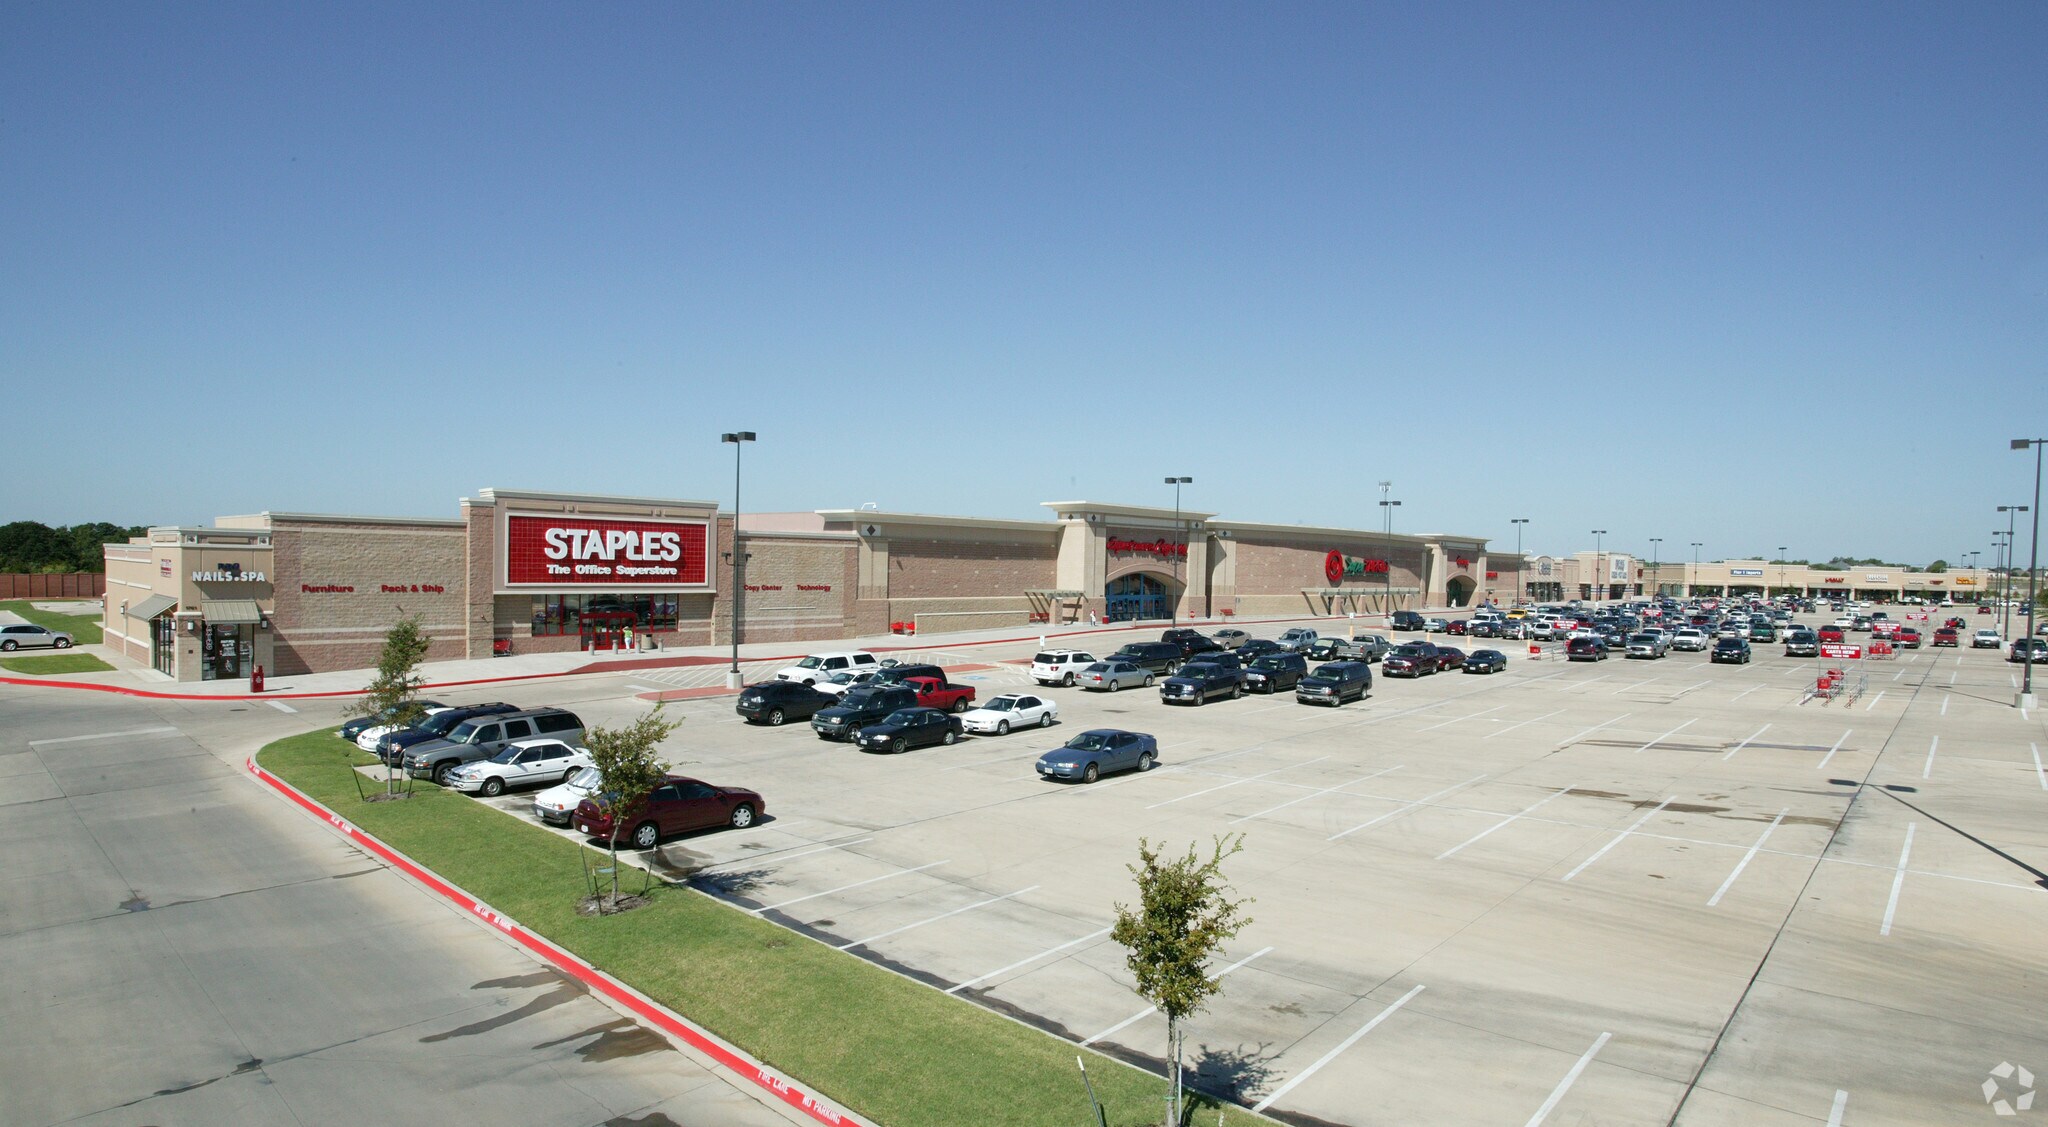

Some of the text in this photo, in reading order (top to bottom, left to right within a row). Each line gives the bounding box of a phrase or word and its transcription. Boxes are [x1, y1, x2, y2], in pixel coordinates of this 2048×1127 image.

[544, 528, 681, 562] STAPLES
[546, 564, 678, 577] The Office Superstore
[302, 584, 354, 593] Furniture
[381, 584, 444, 594] Pack & Ship
[743, 584, 760, 592] Copy
[797, 584, 831, 592] Technology
[758, 1071, 841, 1125] FIRE LANE NO PARKING
